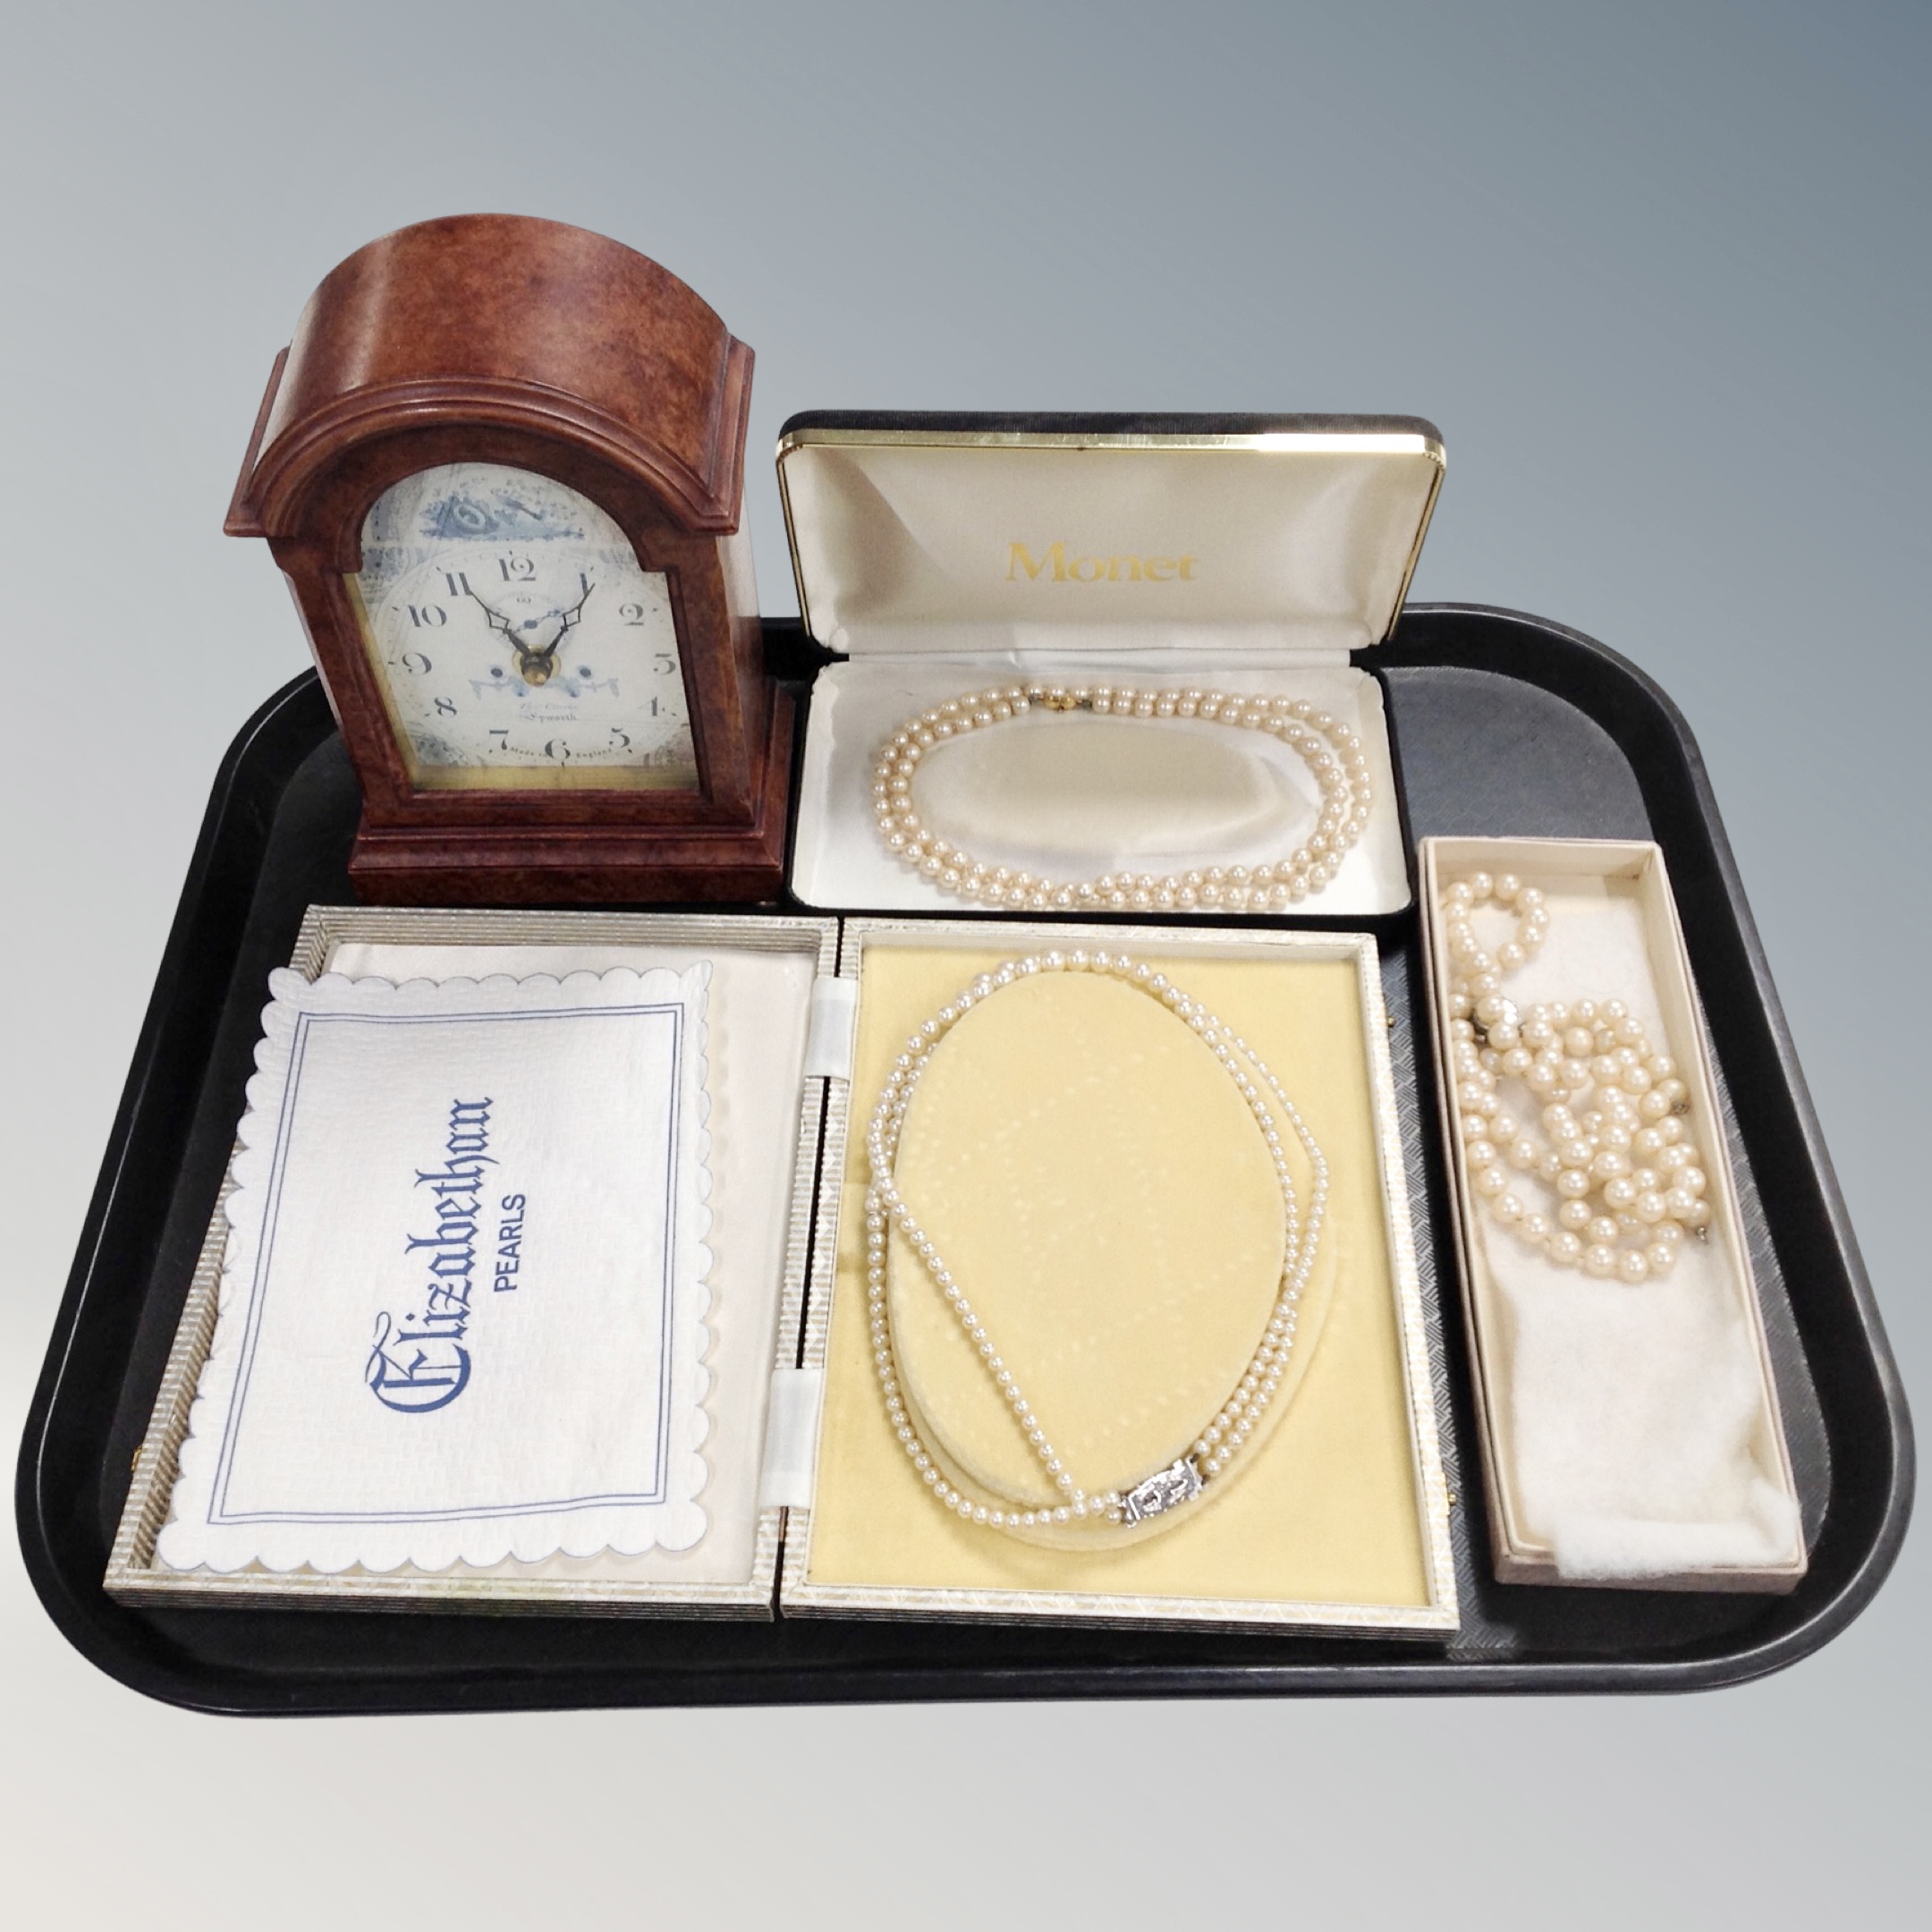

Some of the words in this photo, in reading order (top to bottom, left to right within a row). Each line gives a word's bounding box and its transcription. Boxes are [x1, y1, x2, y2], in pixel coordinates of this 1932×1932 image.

[498, 558, 537, 581] 12
[1005, 540, 1199, 582] Monet
[445, 572, 472, 596] 11
[408, 604, 447, 627] 10
[618, 603, 645, 625] 2
[402, 652, 433, 676] 9
[653, 653, 676, 676] 3
[434, 697, 458, 716] 8
[638, 696, 666, 716] 4
[488, 729, 509, 750] 7
[544, 739, 572, 760] 6
[608, 727, 631, 749] 5
[494, 1193, 527, 1292] PEARLS
[365, 1097, 500, 1413] Elizabethan
